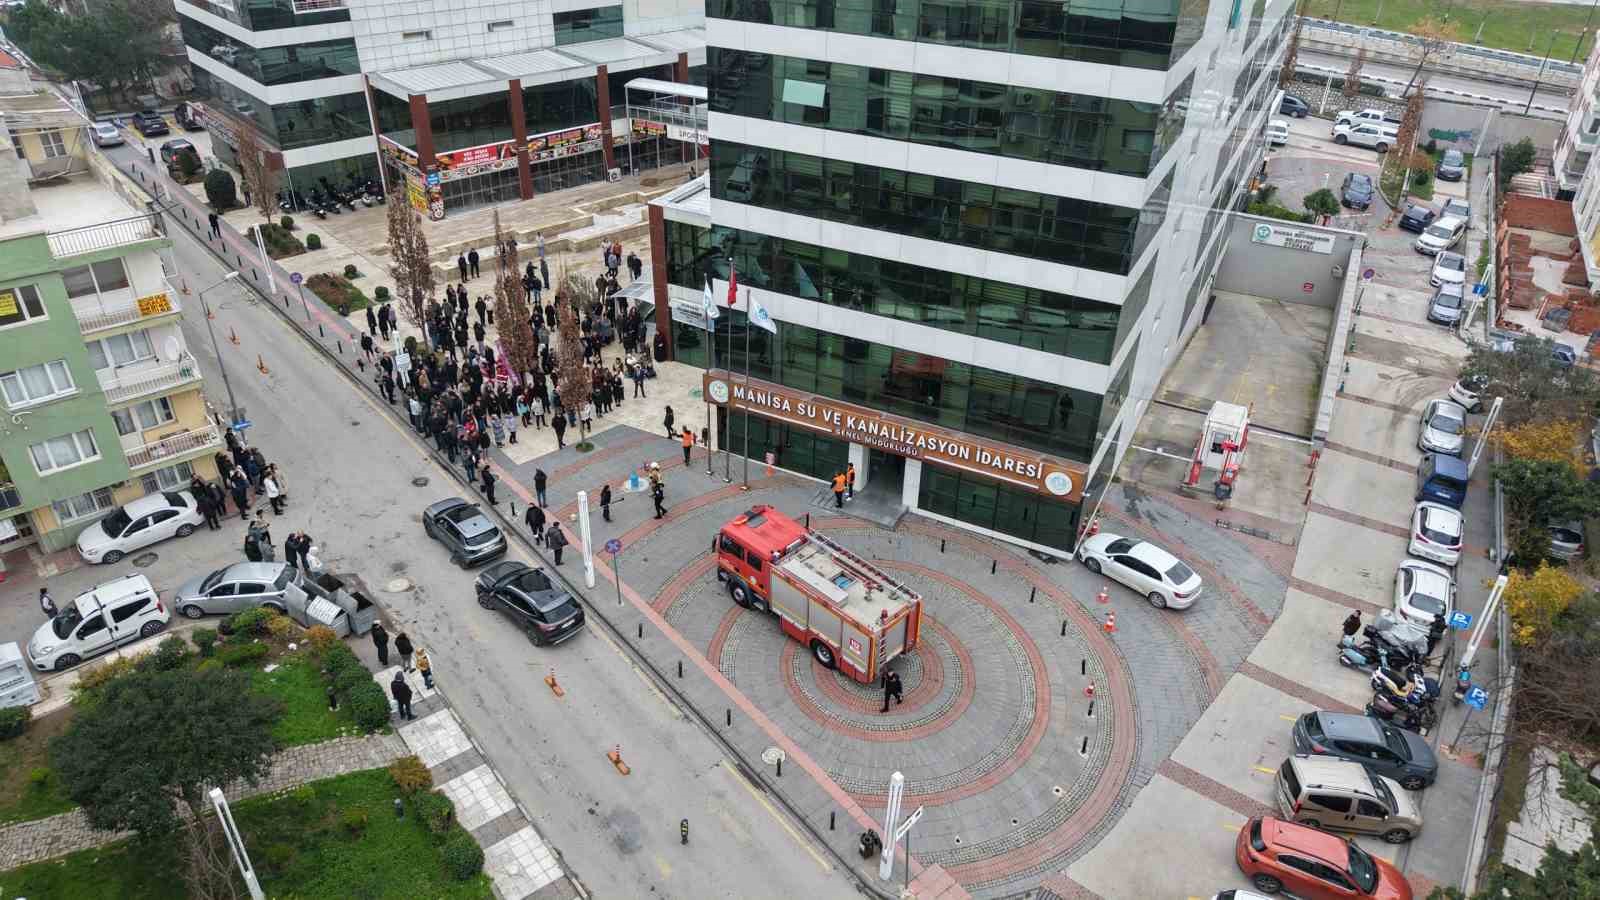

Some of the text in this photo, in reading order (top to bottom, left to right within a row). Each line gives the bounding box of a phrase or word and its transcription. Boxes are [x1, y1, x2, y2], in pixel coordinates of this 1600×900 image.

[734, 385, 1043, 480] MANİSA SU VE KANALİZASYON İDARESİ
[836, 429, 861, 441] ENEL
